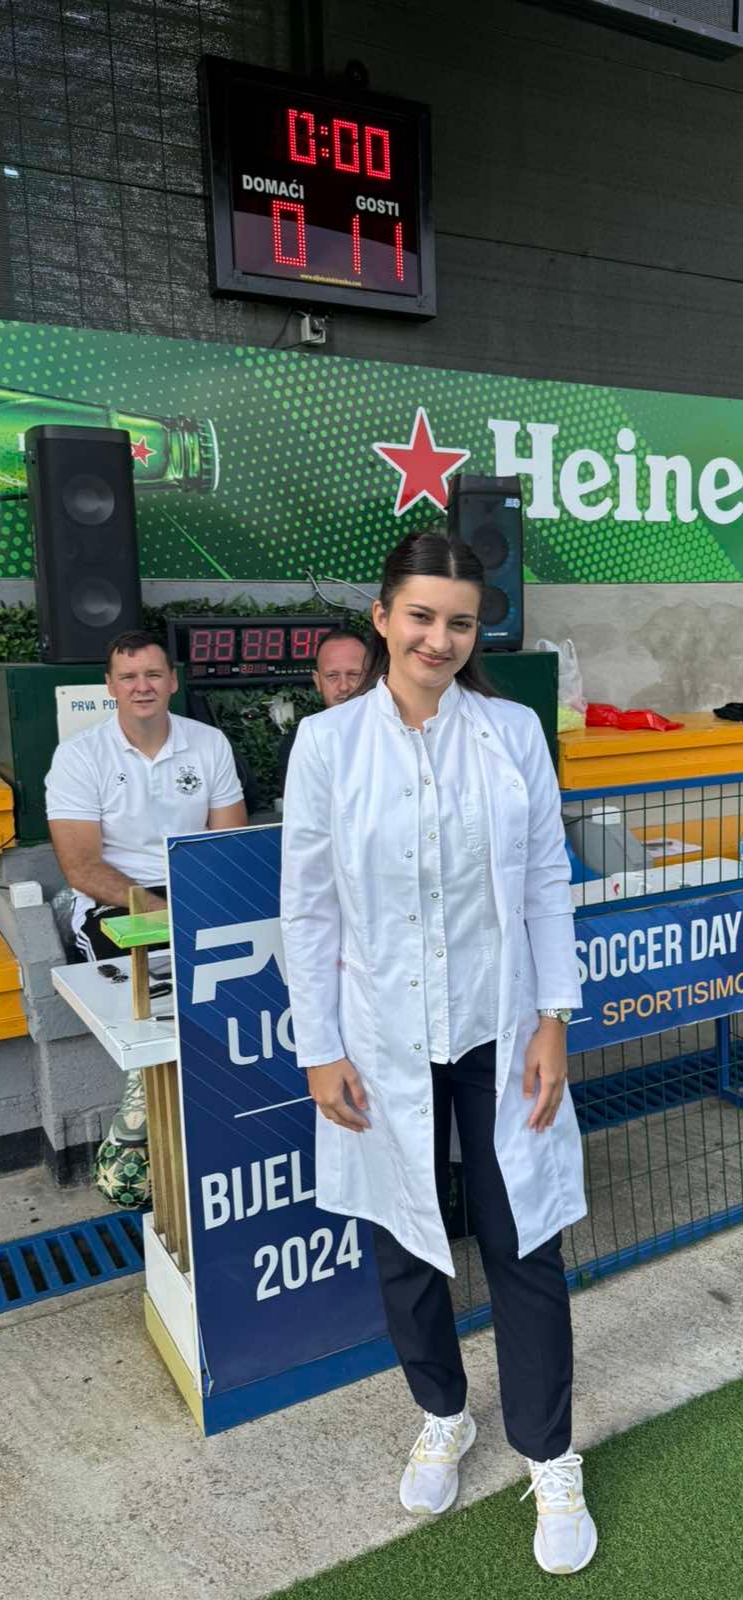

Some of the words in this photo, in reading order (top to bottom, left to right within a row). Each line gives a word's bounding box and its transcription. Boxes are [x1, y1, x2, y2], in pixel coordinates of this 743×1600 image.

[242, 174, 304, 199] DOMAĆI
[356, 195, 399, 217] GOSTI
[272, 200, 307, 268] 0
[487, 419, 743, 525] Heine
[71, 700, 97, 711] PRVA
[575, 923, 683, 985] SOCCER
[690, 911, 742, 962] DAY
[201, 1150, 317, 1231] BIJEL
[253, 1218, 363, 1302] 2024
